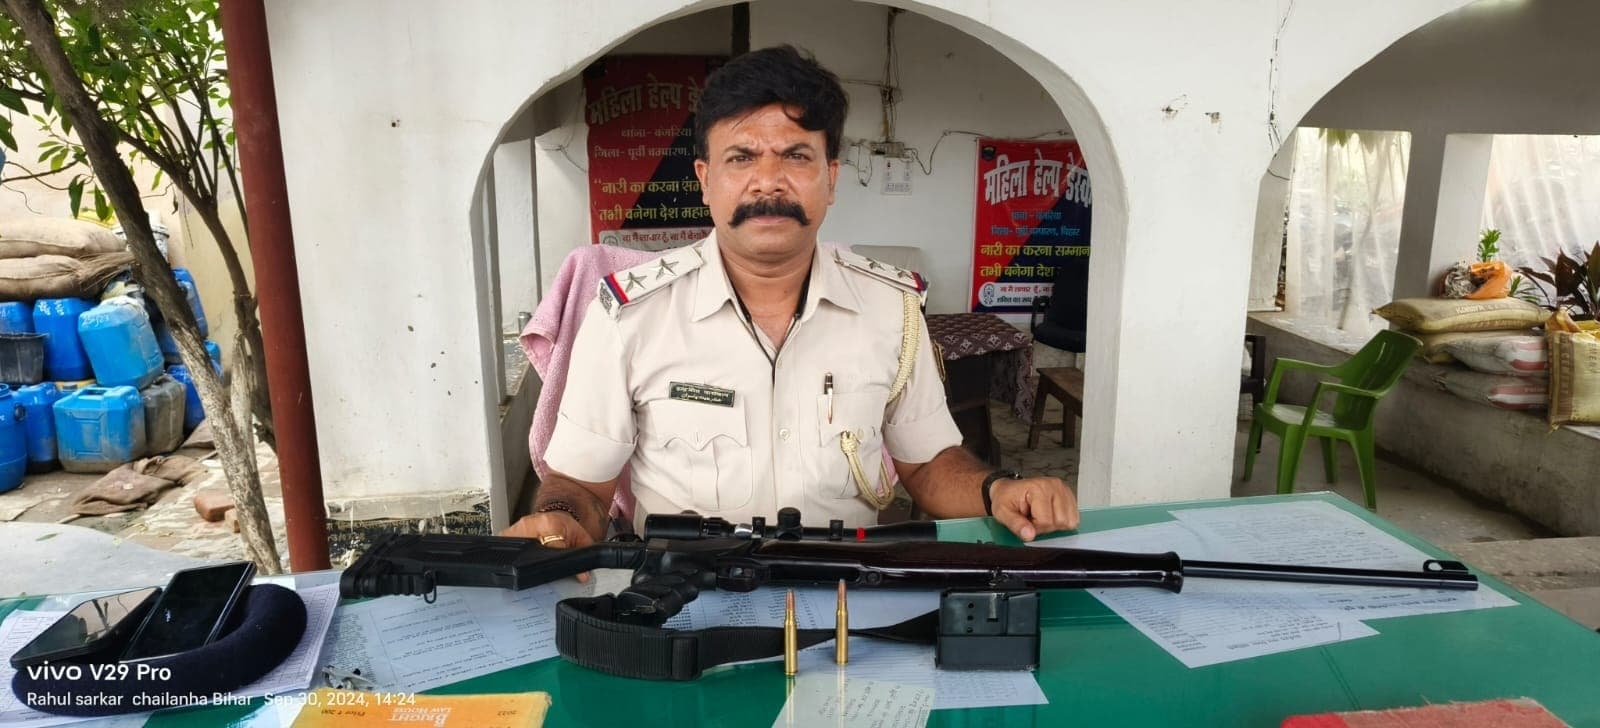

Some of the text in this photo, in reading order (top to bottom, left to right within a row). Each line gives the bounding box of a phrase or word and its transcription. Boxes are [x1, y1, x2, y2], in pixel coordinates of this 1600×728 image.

[984, 154, 1030, 205] महिला
[1033, 147, 1063, 197] हेल्प
[630, 182, 646, 193] का
[648, 181, 680, 193] करना
[599, 204, 623, 221] तभी
[625, 205, 657, 220] बनेगा
[659, 204, 679, 221] देश
[981, 241, 1003, 256] नारी
[1005, 245, 1021, 256] का
[1023, 245, 1053, 257] करना
[980, 262, 1002, 278] तभी
[1004, 263, 1034, 278] बनेगा
[1036, 263, 1055, 278] देश
